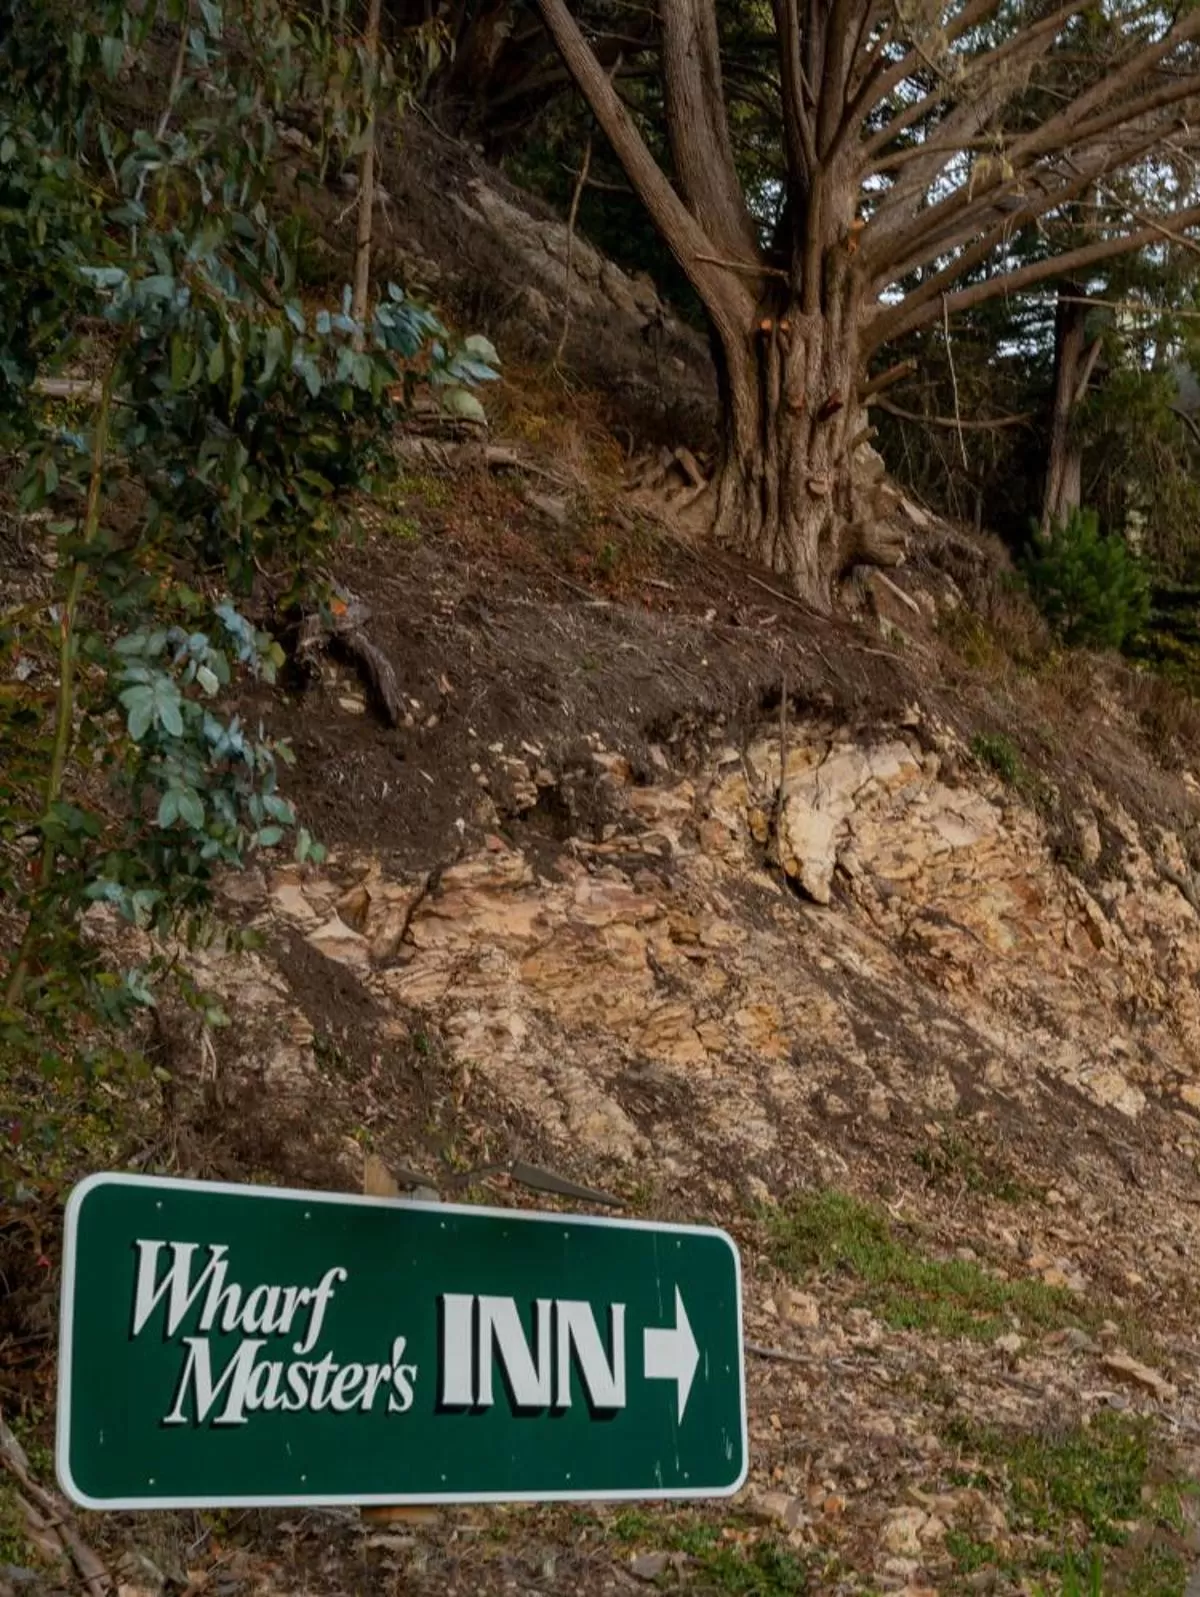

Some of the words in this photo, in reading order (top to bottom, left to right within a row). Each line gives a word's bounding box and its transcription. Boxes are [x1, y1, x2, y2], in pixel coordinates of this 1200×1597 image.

[132, 1239, 347, 1355] Wharf
[441, 1292, 626, 1408] INN
[163, 1336, 417, 1424] Master's
